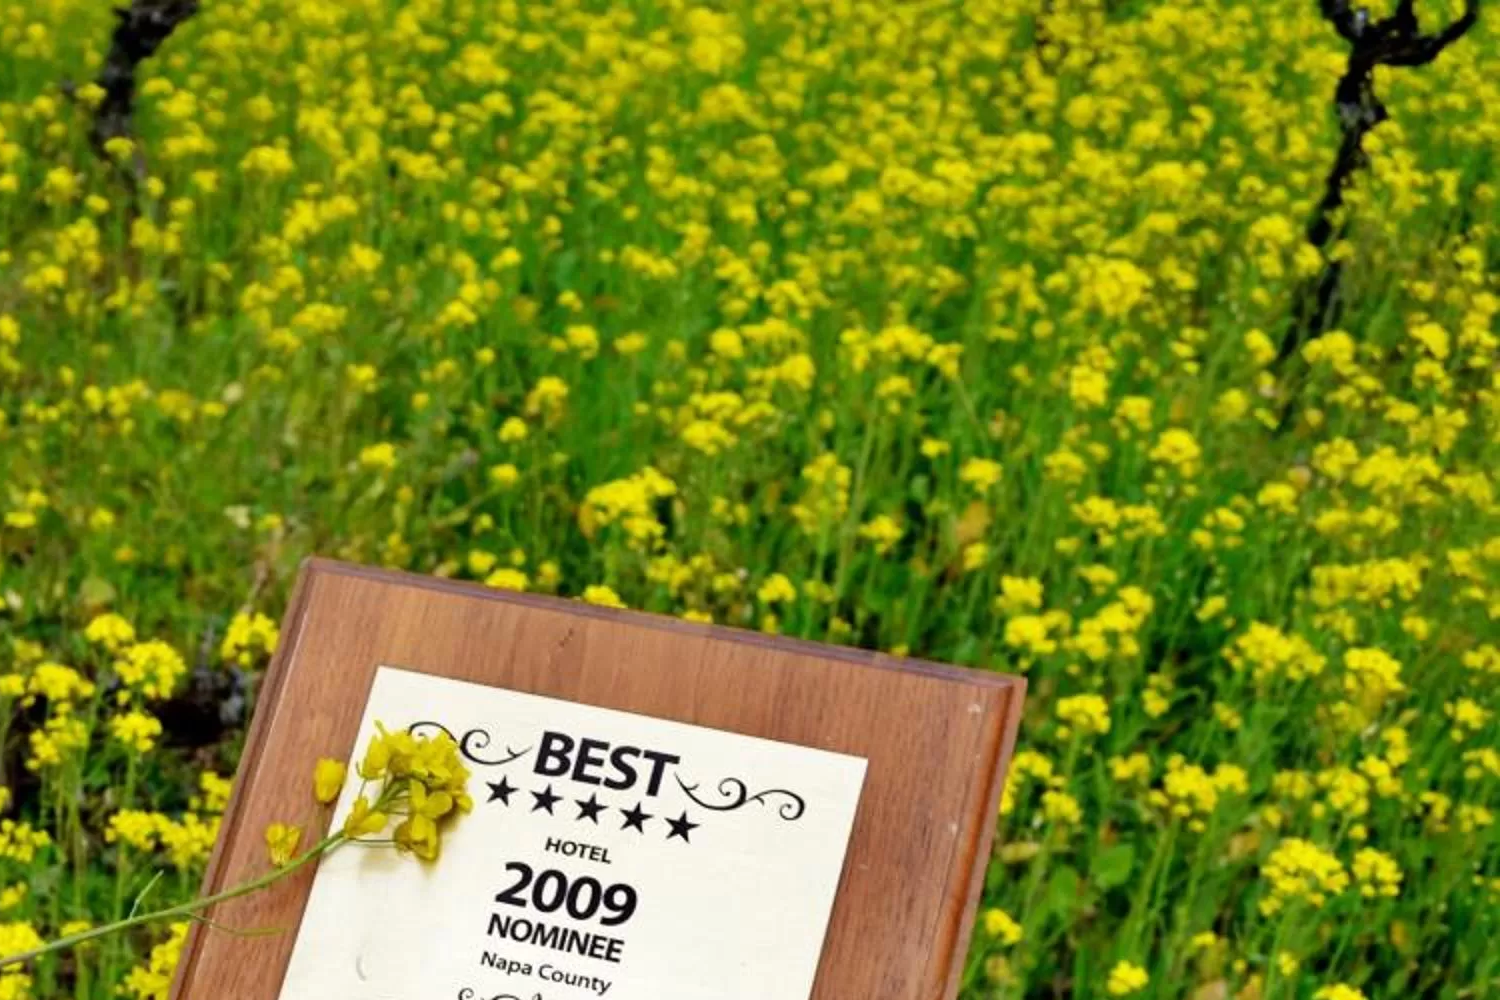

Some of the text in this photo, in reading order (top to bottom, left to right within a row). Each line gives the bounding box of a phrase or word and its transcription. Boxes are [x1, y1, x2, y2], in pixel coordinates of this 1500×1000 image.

[533, 731, 681, 797] BEST
[545, 837, 612, 865] HOTEL
[495, 861, 638, 927] 2009
[487, 913, 625, 963] NOMINEE
[481, 951, 612, 996] Napa County
